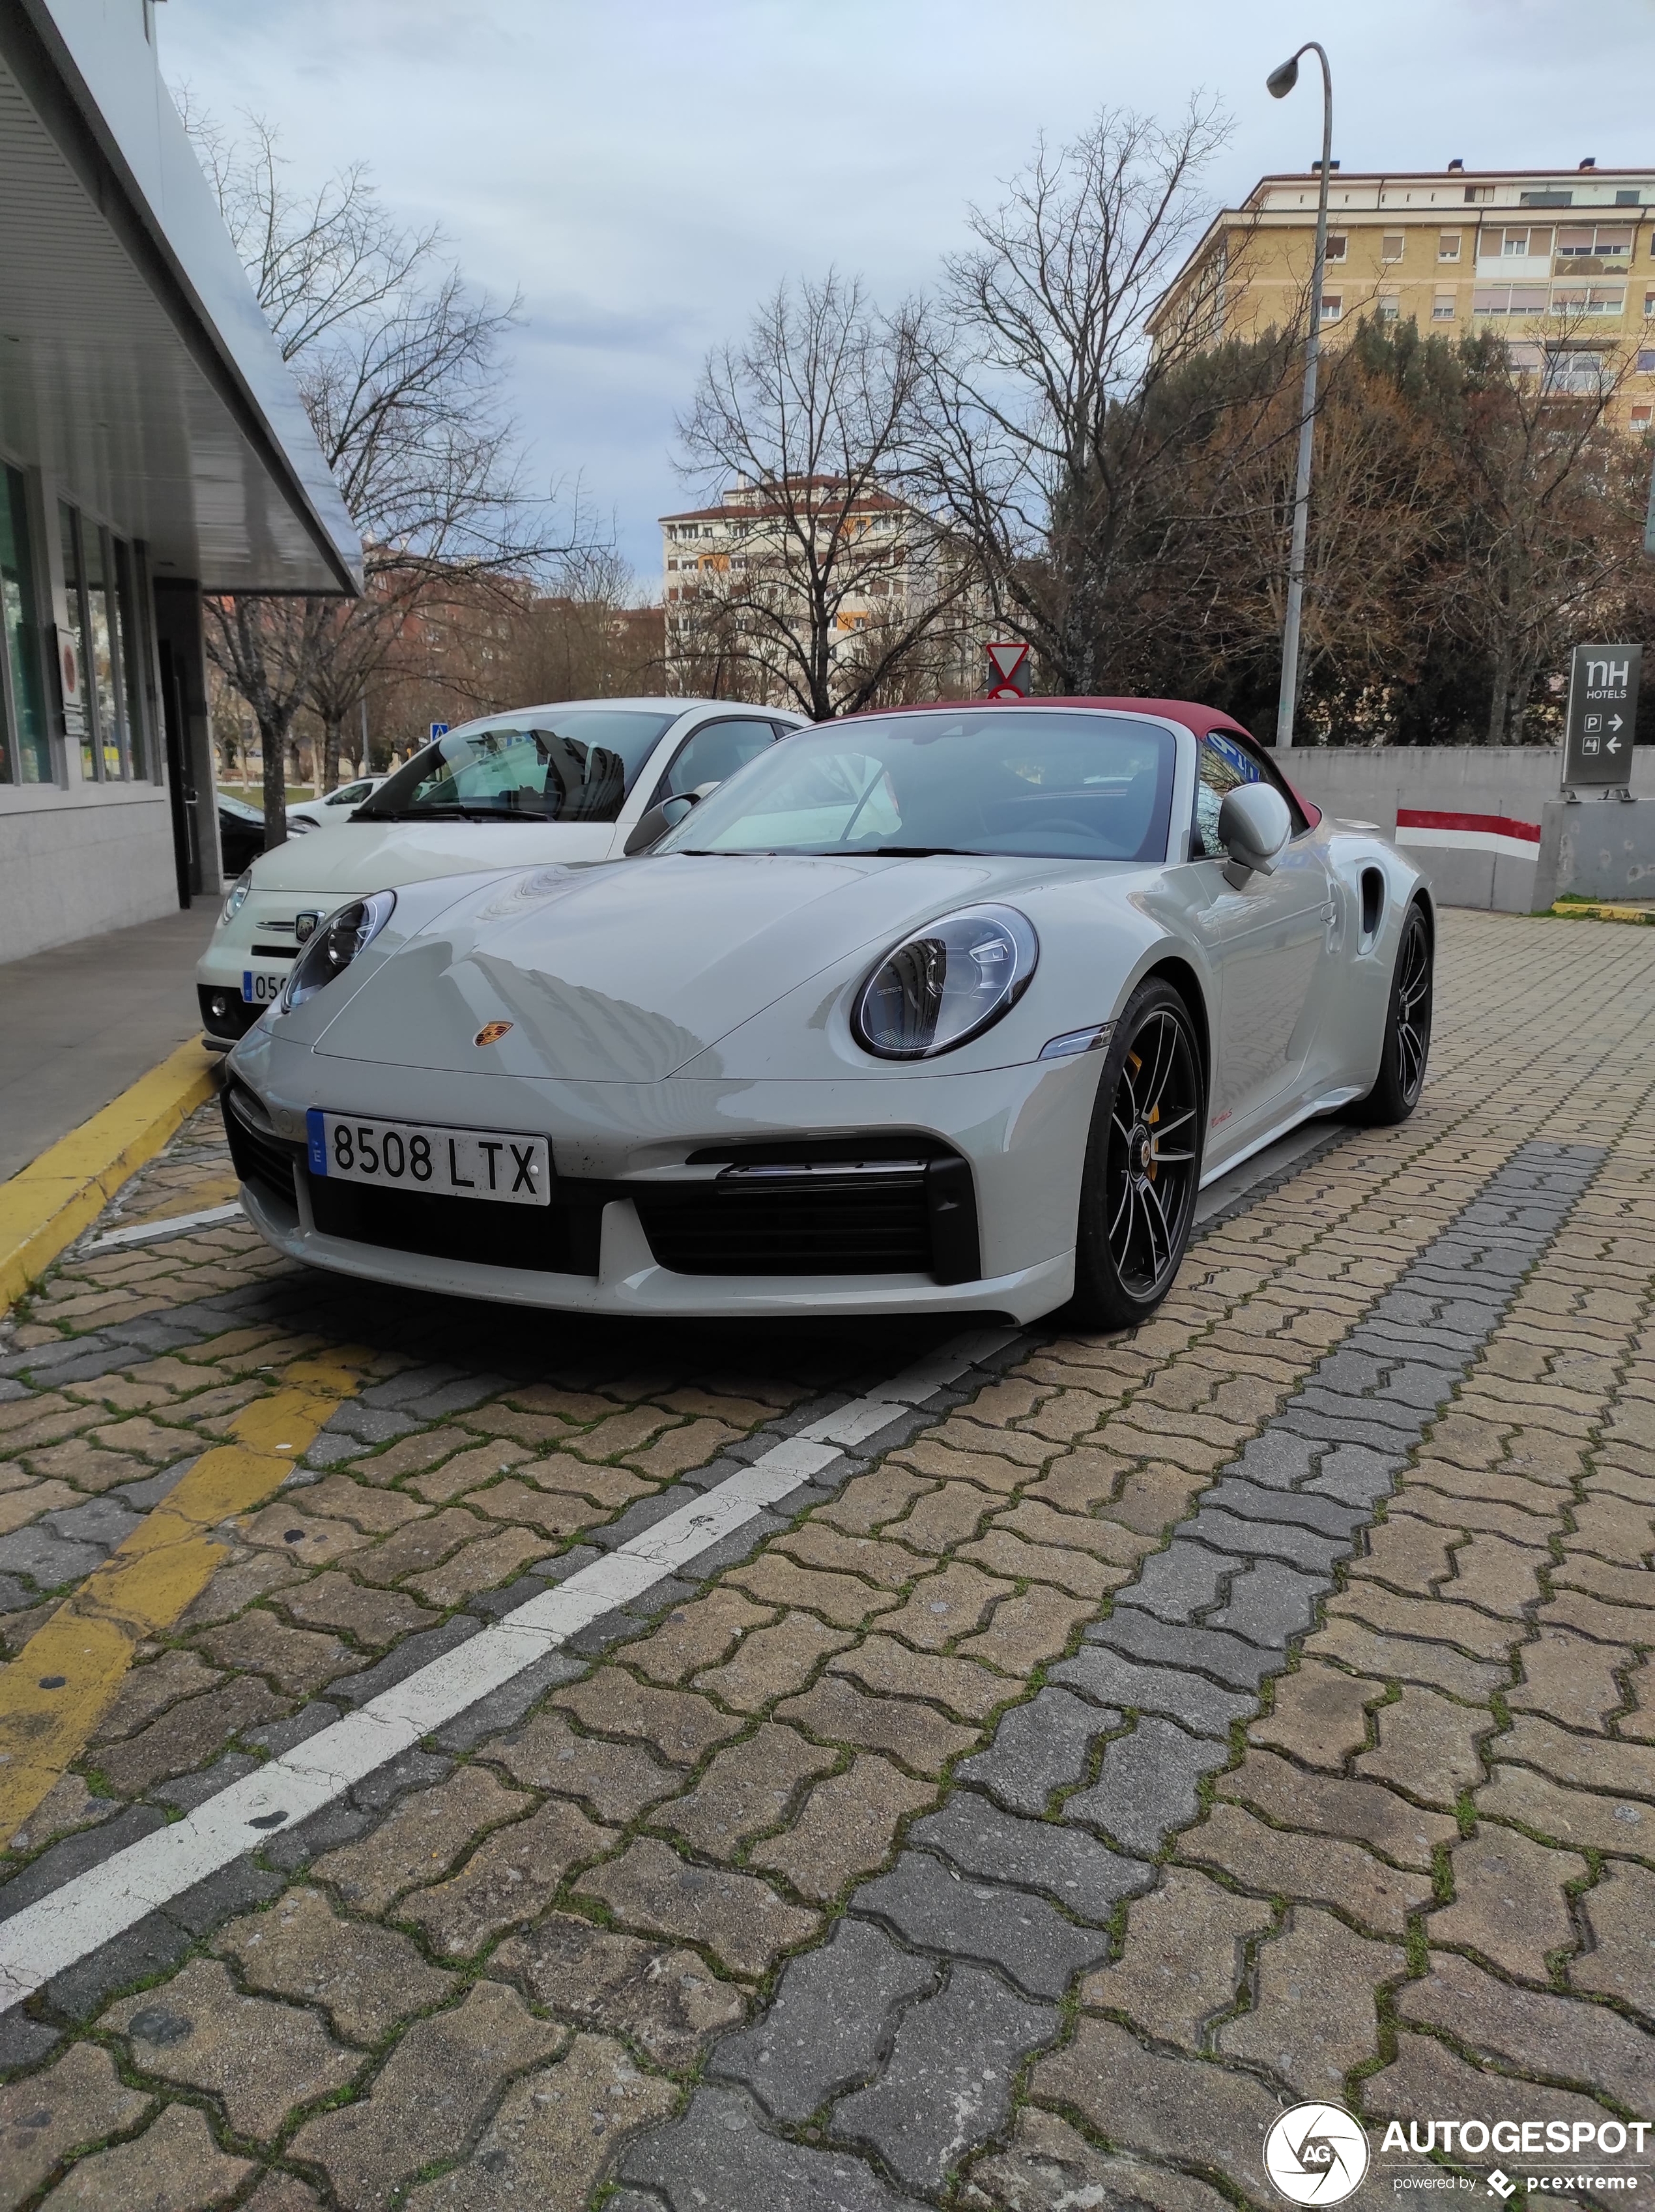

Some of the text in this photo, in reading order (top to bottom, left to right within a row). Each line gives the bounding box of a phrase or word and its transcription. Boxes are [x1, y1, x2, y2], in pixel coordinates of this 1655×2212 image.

[1587, 690, 1627, 699] HOTELS
[1587, 717, 1598, 729] P
[313, 1149, 322, 1163] E
[334, 1124, 538, 1195] 8508 LTX
